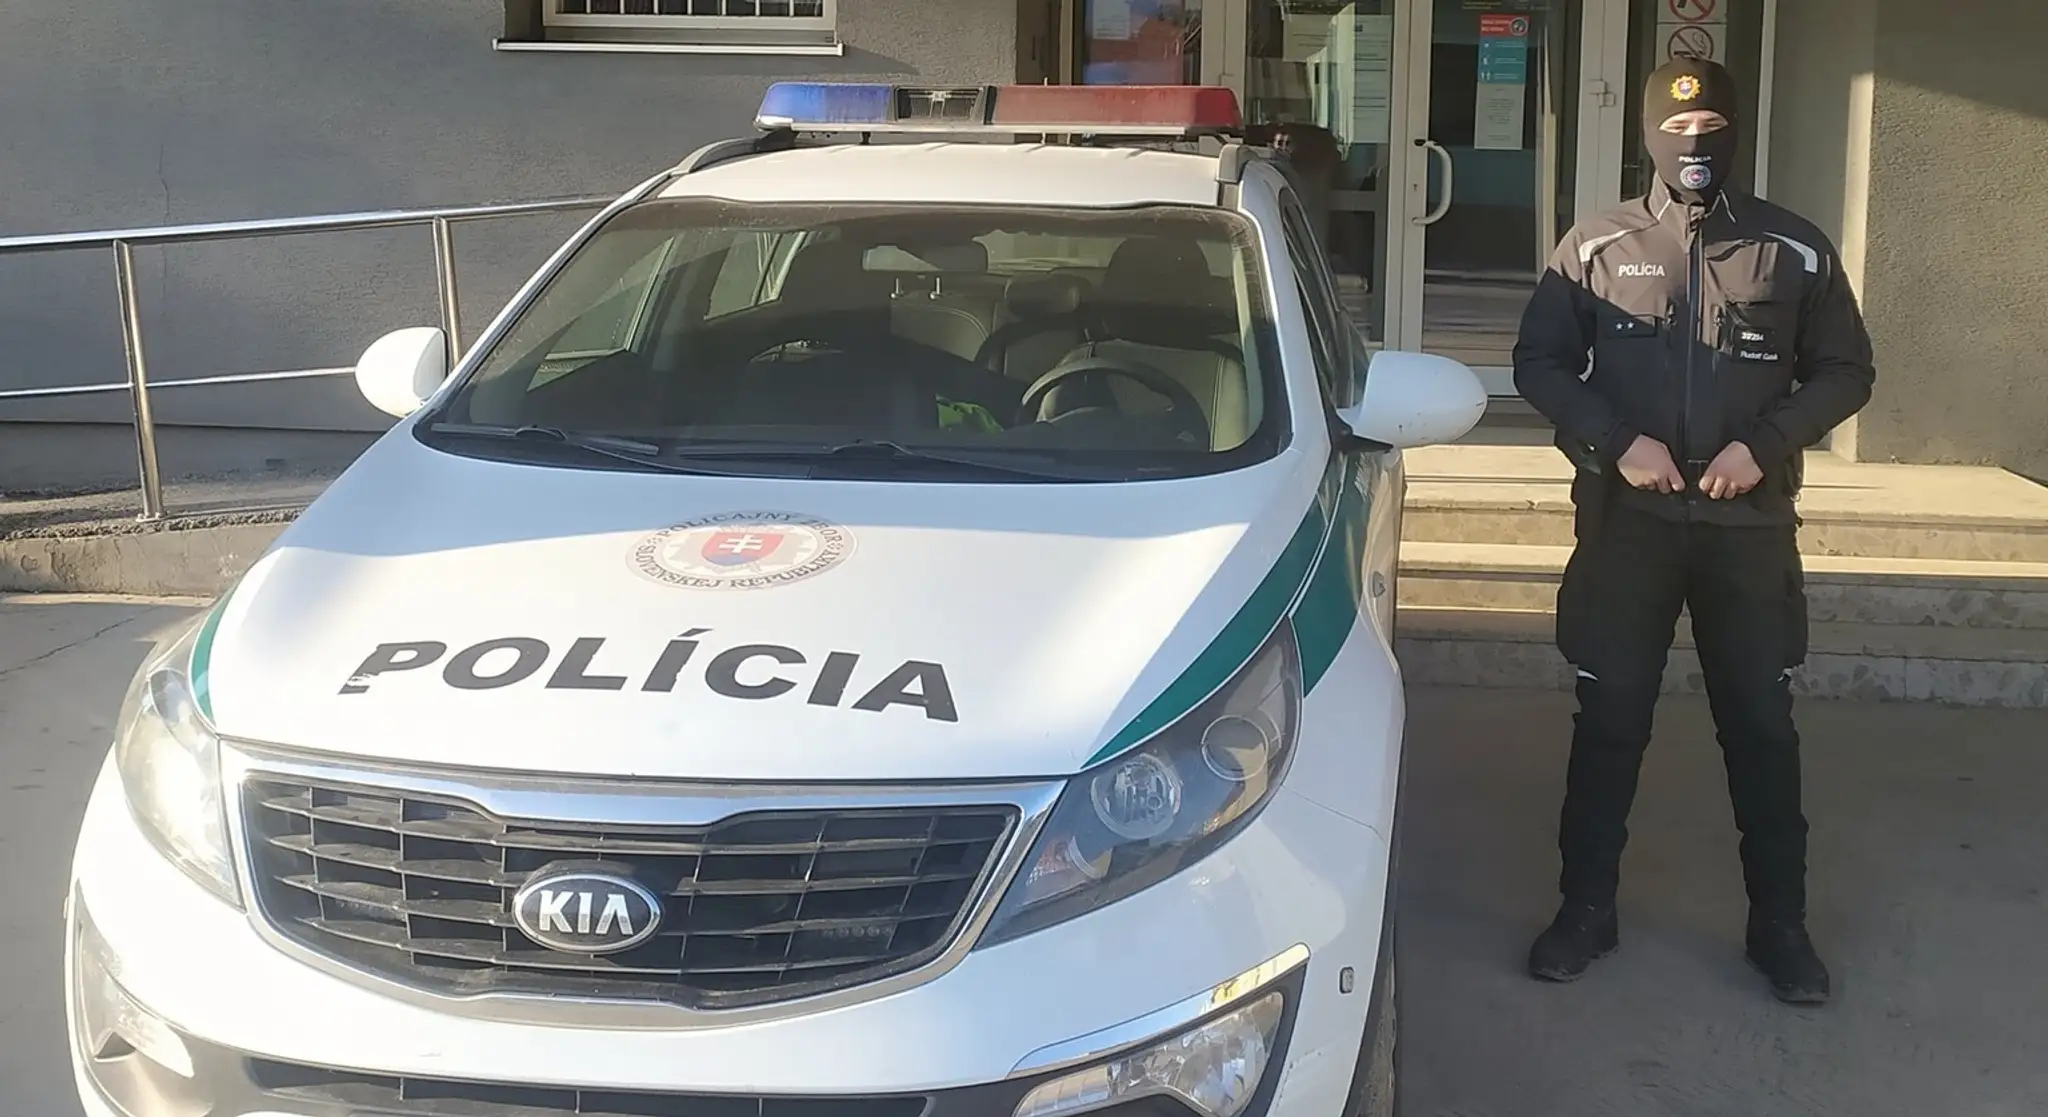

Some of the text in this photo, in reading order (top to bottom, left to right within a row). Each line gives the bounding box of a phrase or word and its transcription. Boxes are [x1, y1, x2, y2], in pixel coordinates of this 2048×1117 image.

[1618, 261, 1666, 278] POLÍCIA
[635, 544, 841, 588] SLOVENSKEJ REPUBLIKY
[337, 627, 959, 723] POLÍCIA
[538, 890, 634, 936] KIA
